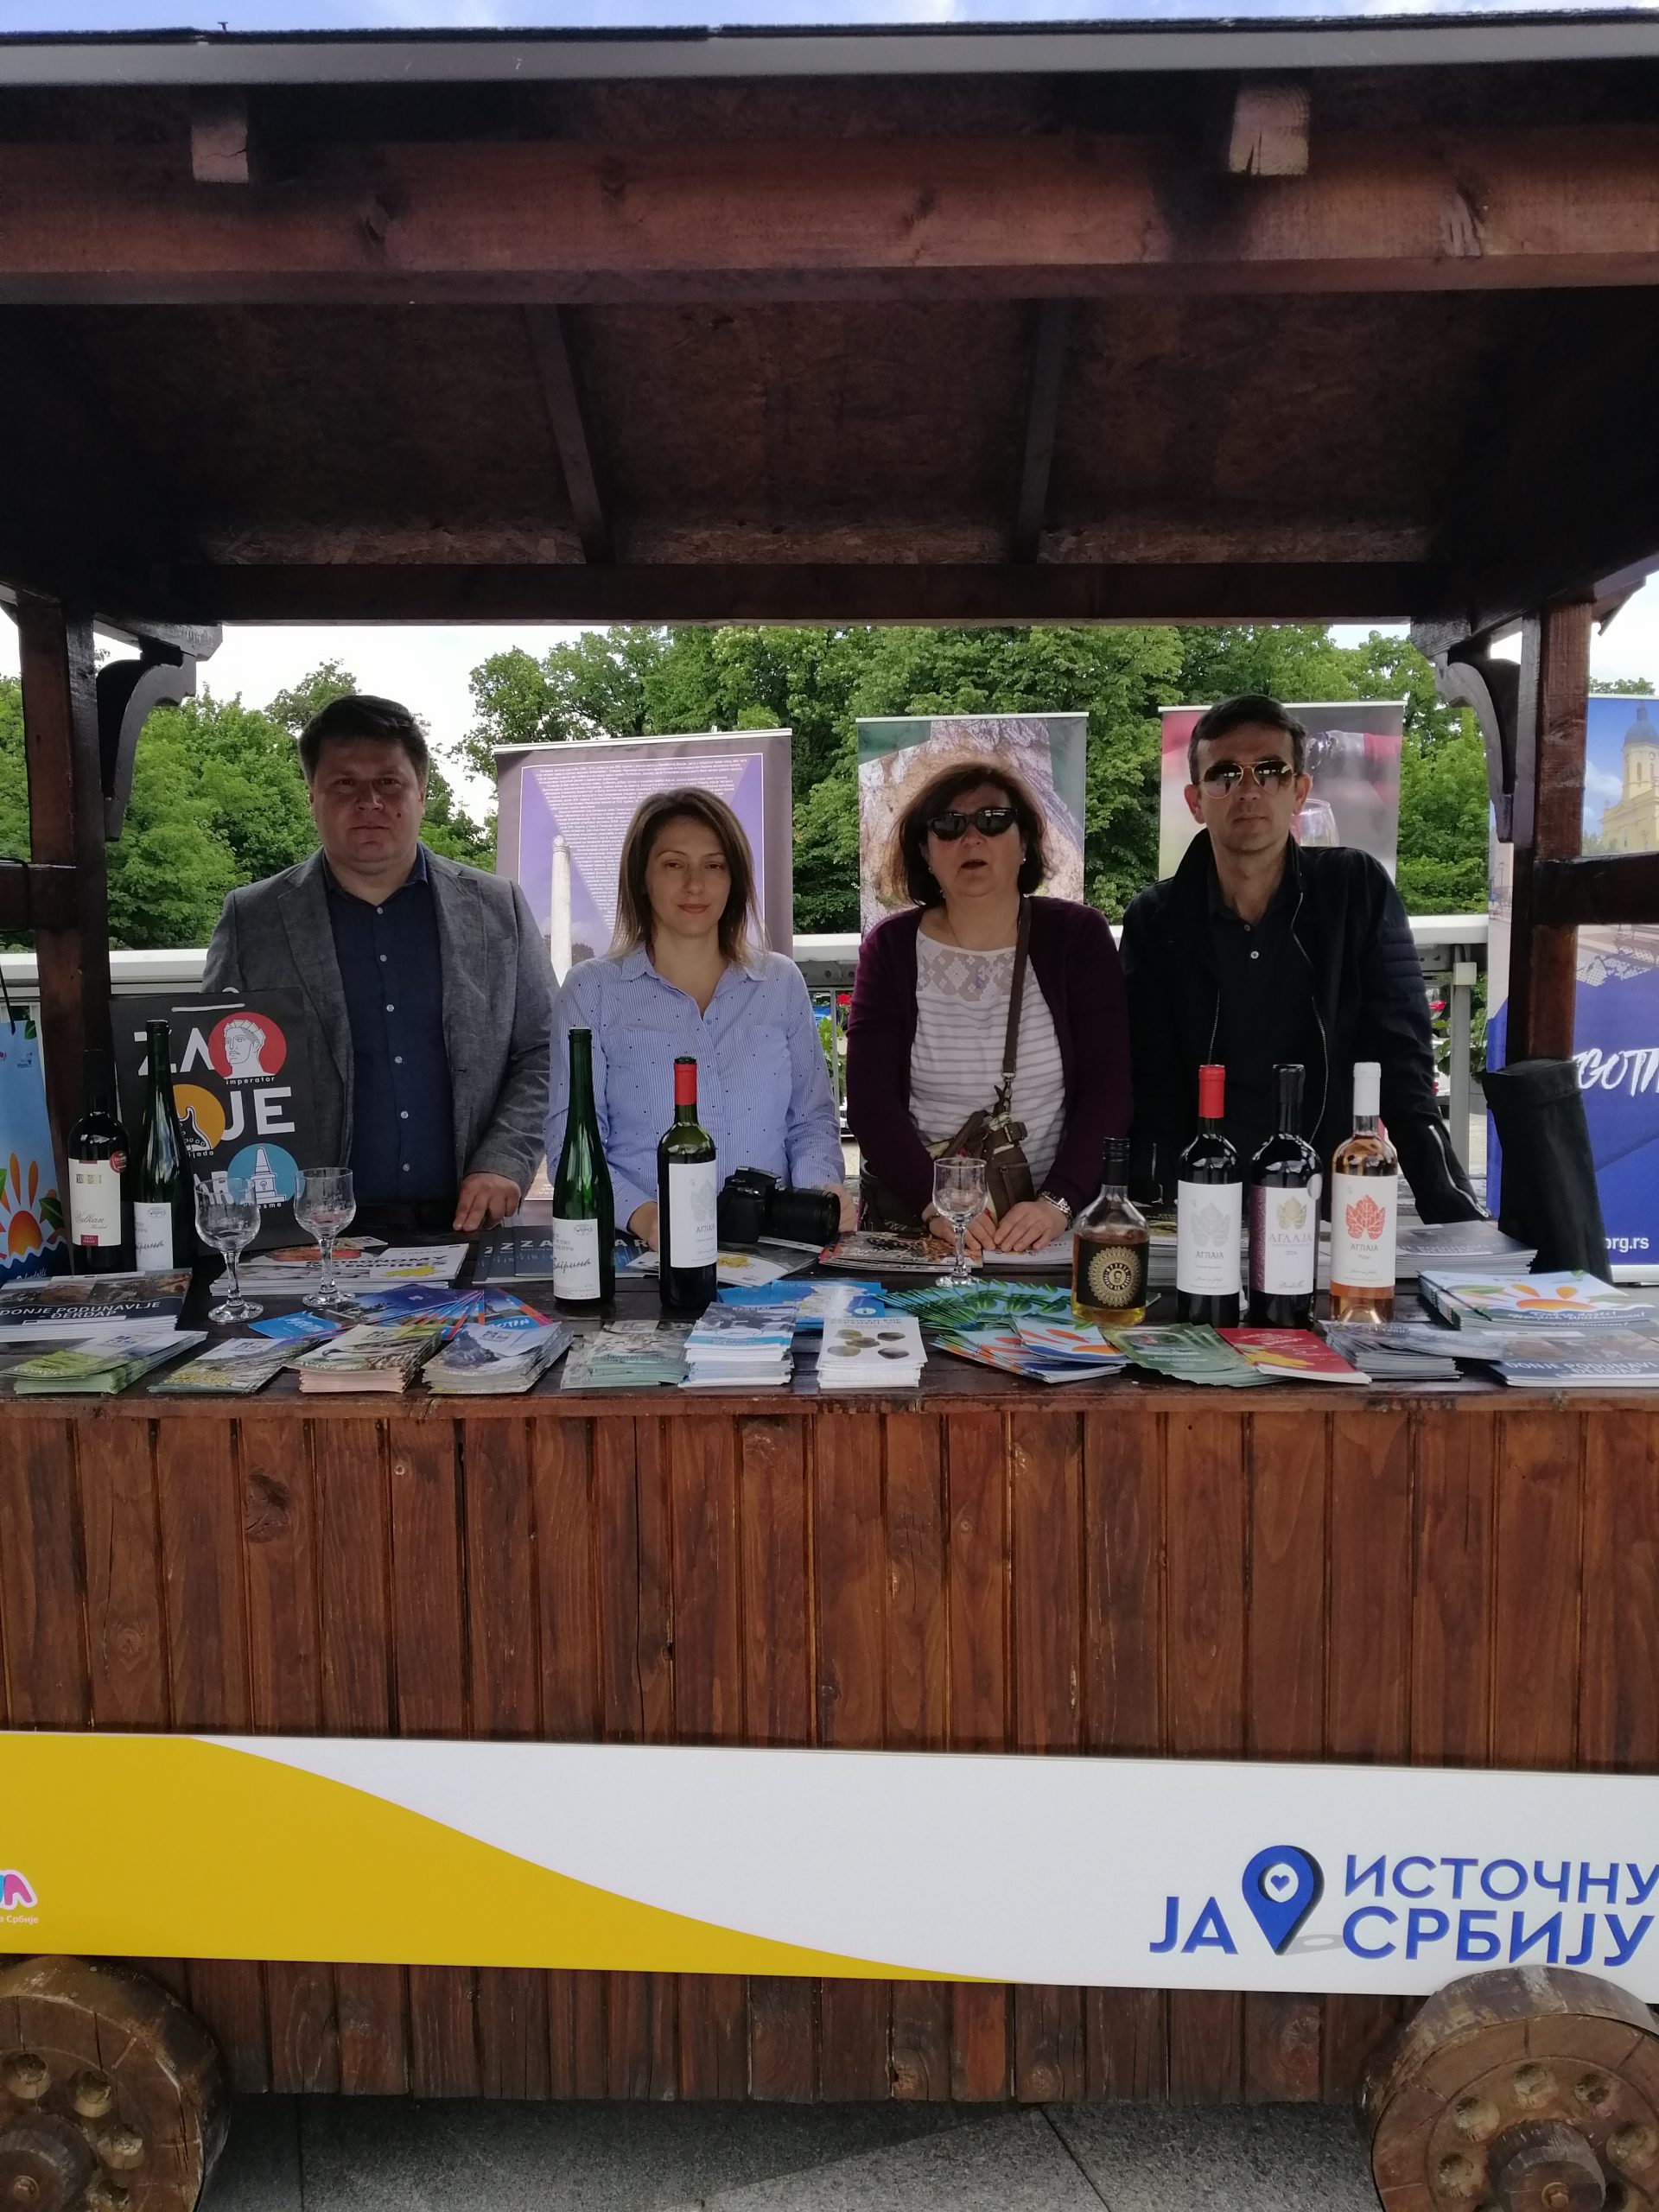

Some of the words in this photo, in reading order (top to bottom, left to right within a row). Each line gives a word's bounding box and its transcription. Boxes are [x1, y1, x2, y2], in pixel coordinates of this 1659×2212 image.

[226, 1077, 276, 1085] imperator
[221, 1087, 296, 1141] JE
[74, 1210, 105, 1224] Vulkan
[0, 1307, 51, 1316] DONJE
[56, 1301, 162, 1313] PODUNAVLJE
[51, 1310, 118, 1319] ĐERDAP
[1344, 1853, 1659, 1906] ИСТОЧНУ
[6, 1915, 39, 1925] Србије
[1149, 1896, 1237, 1955] ЈА
[1342, 1906, 1654, 1967] СРБИЈУ
